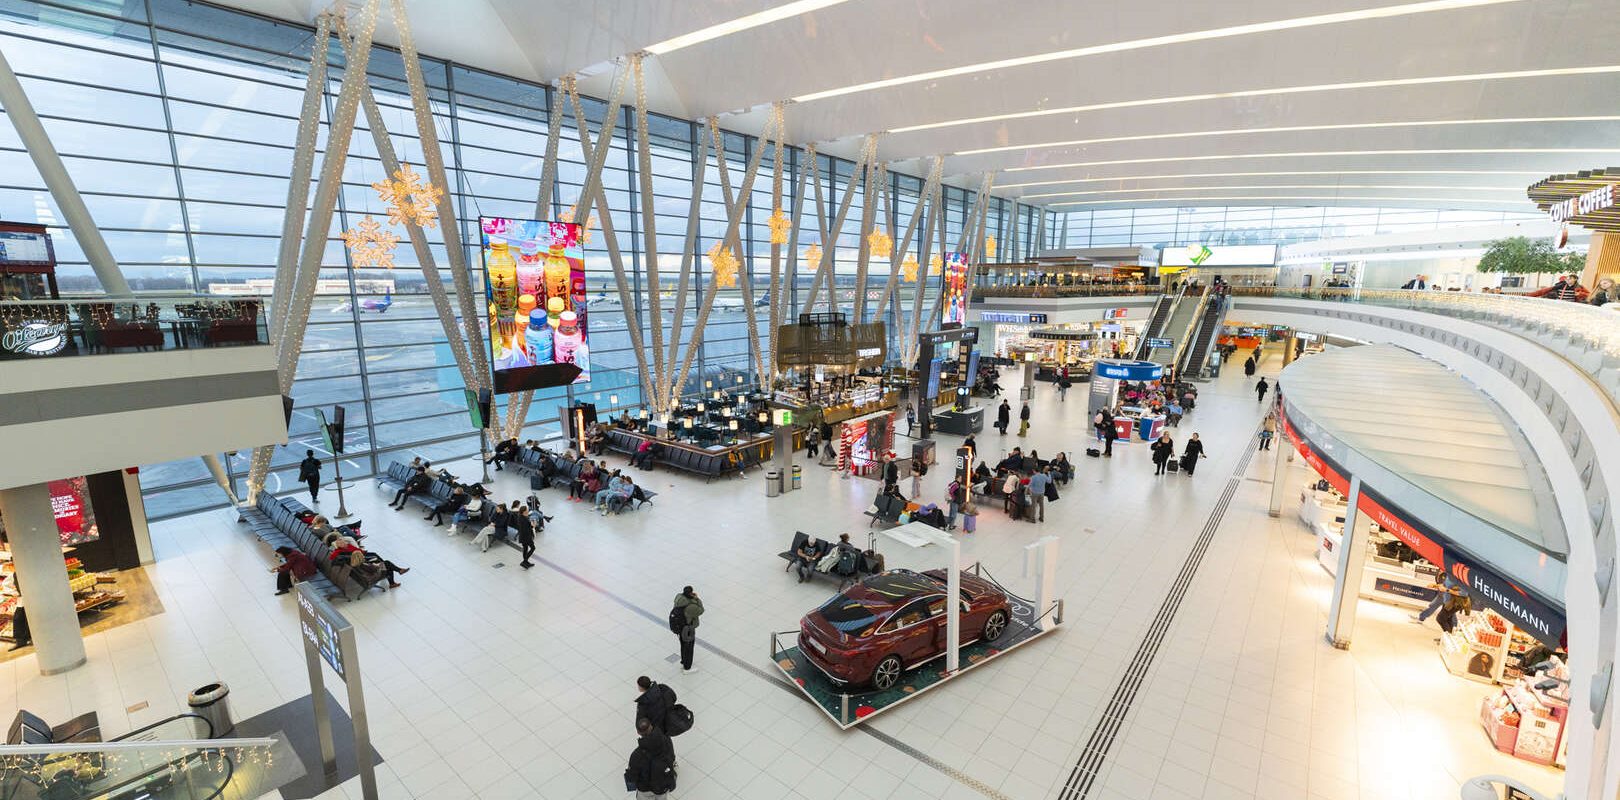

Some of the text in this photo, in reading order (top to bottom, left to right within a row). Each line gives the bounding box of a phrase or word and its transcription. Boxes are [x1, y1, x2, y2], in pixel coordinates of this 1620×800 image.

[1550, 185, 1613, 222] COSTA COFFEE
[1378, 512, 1421, 546] TRAVEL VALUE
[1474, 576, 1549, 635] HEINEMANN
